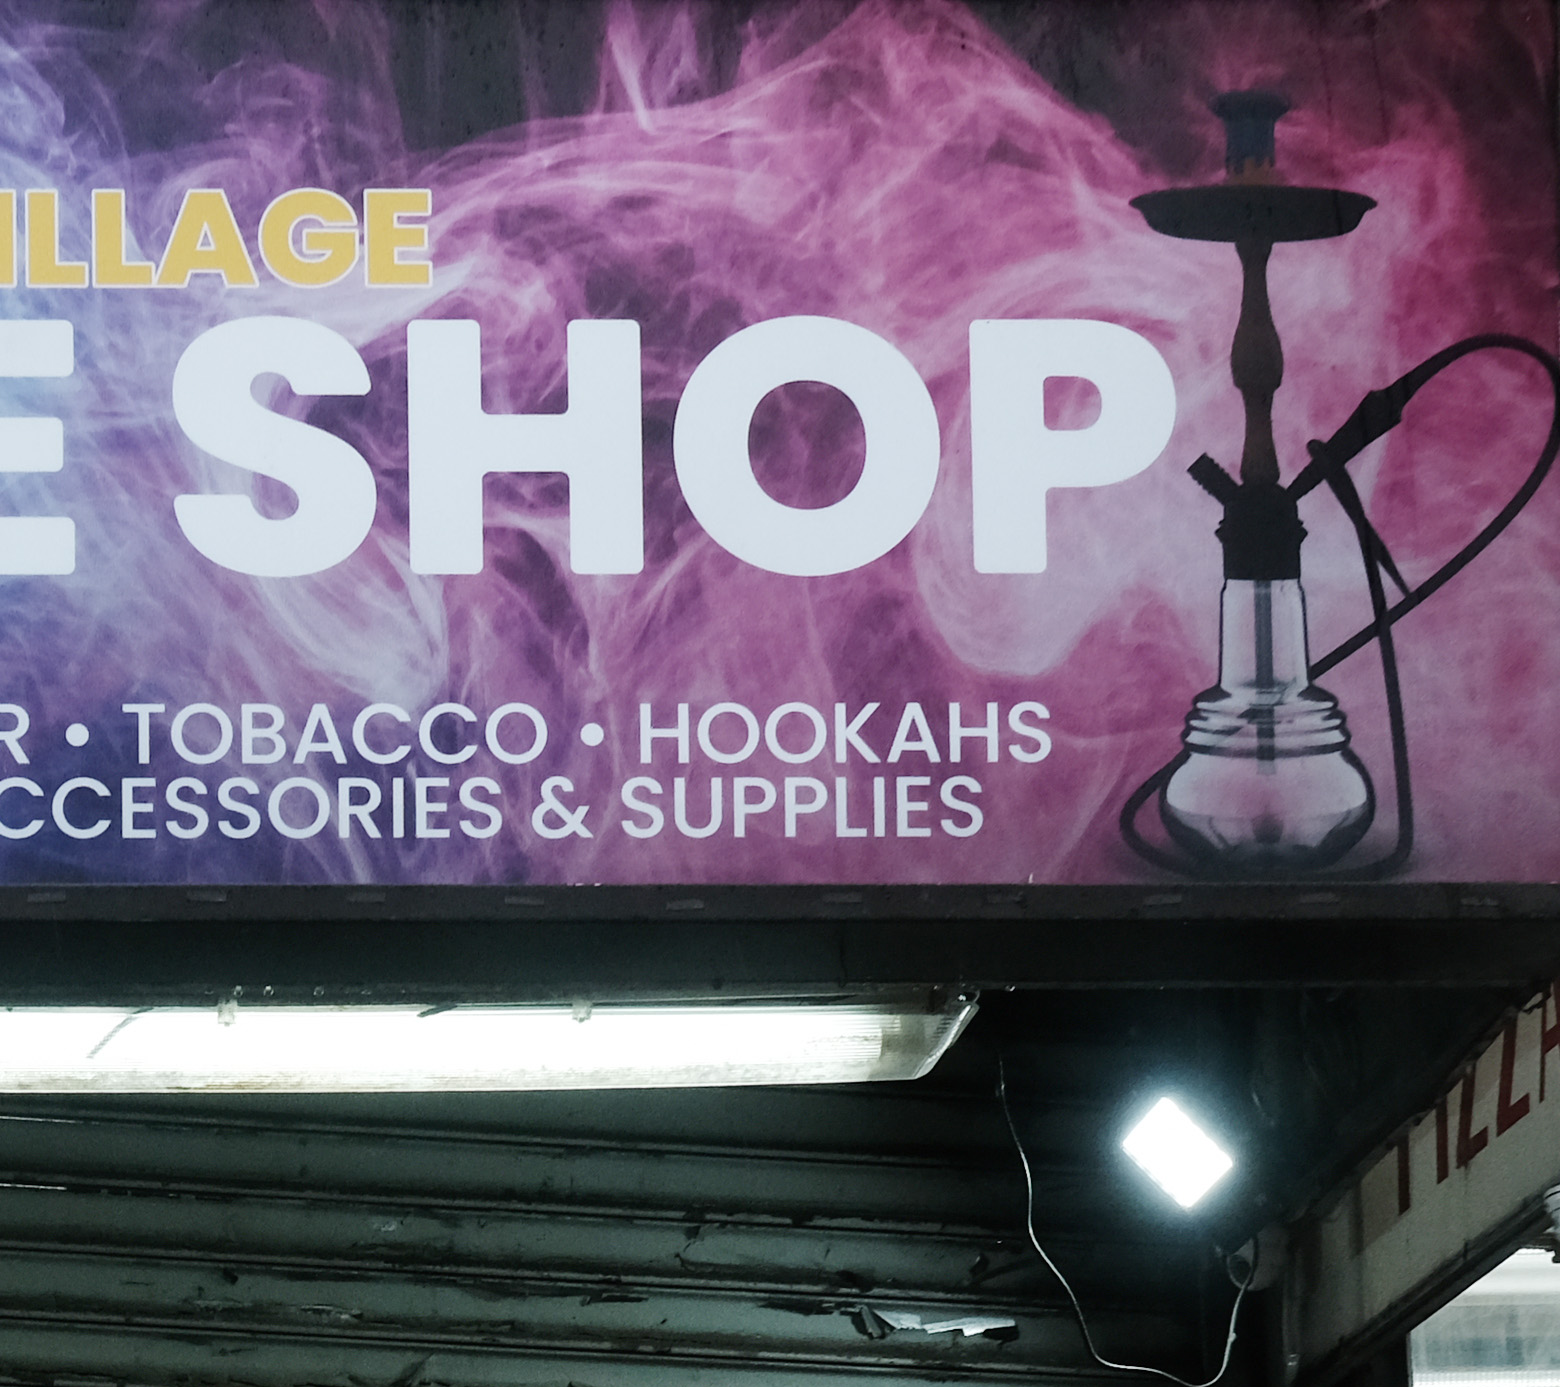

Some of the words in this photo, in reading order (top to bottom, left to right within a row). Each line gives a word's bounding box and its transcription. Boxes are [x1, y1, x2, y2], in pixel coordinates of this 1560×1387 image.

[172, 314, 1178, 578] SHOP
[123, 701, 549, 766] TOBACCO
[639, 701, 1053, 766] HOOKAHS
[538, 776, 594, 838] &
[621, 776, 985, 839] SUPPLIES
